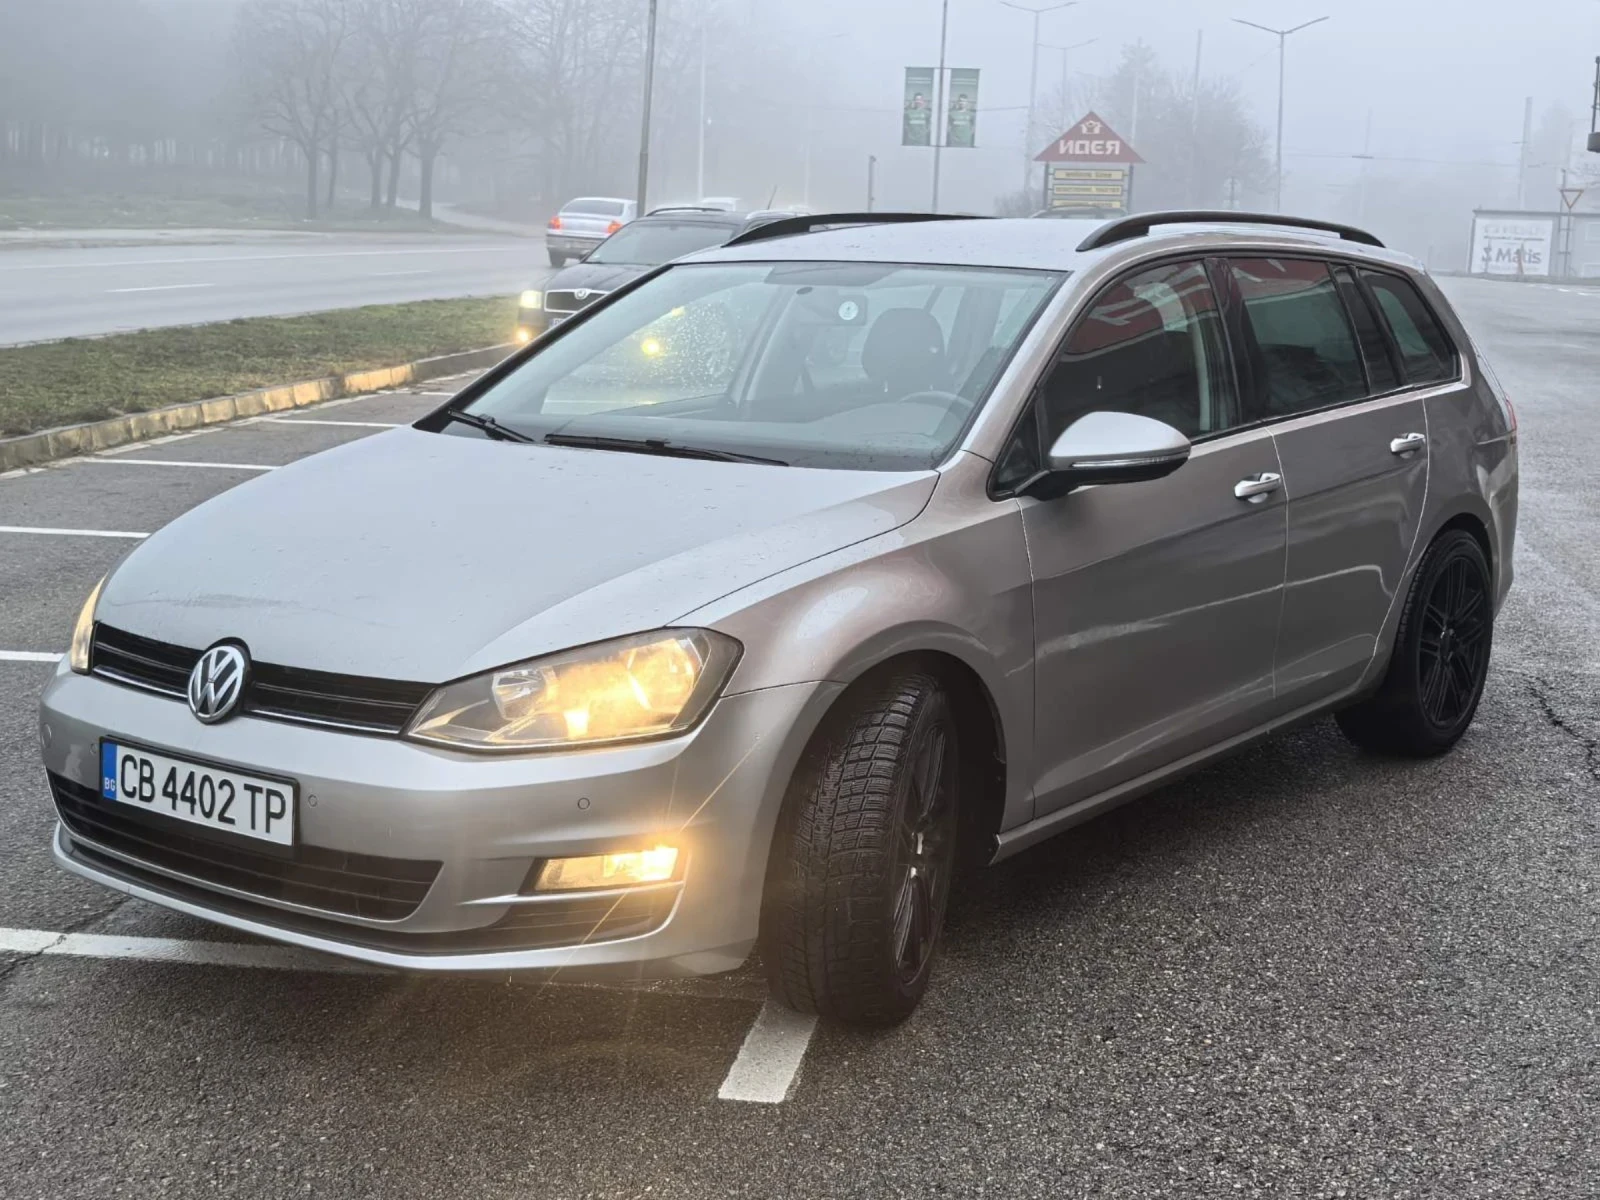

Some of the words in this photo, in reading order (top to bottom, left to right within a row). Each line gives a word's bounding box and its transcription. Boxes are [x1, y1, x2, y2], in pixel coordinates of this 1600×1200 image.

[104, 777, 116, 791] BG
[120, 753, 156, 803] CB
[162, 765, 236, 826] 4402
[243, 782, 287, 834] TP
